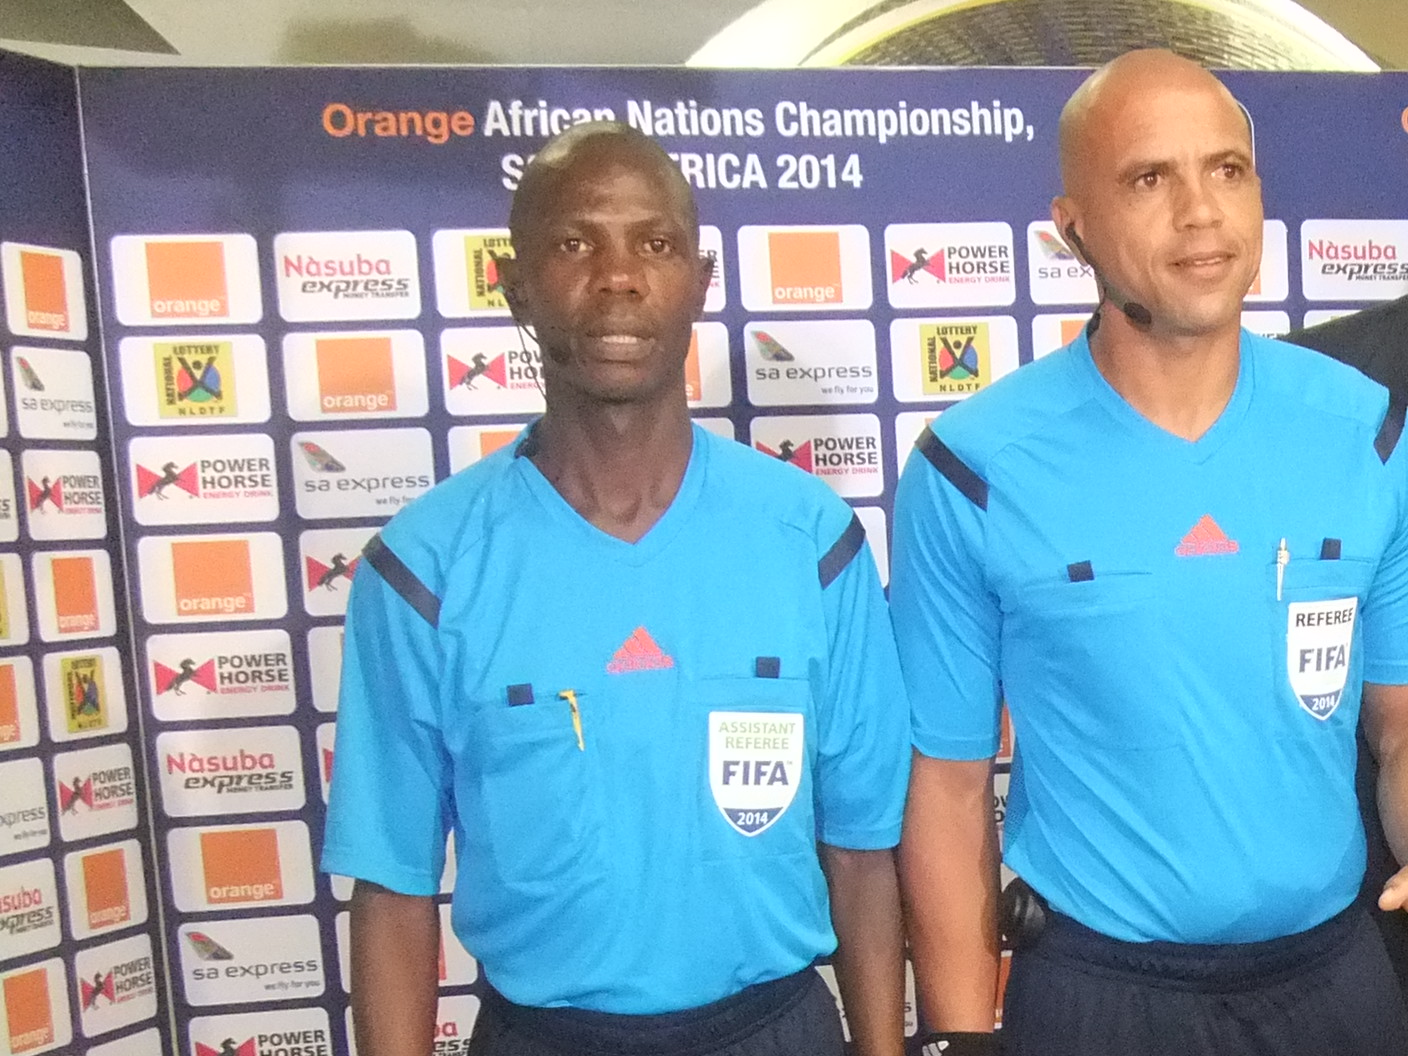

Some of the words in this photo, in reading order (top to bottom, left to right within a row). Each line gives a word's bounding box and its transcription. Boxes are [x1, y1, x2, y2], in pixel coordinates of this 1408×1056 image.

[323, 103, 475, 144] Orange
[627, 100, 764, 138] Nations
[775, 101, 1034, 143] Championship,
[776, 153, 863, 188] 2014
[947, 245, 1009, 260] POWER
[1308, 240, 1397, 260] Nàsuba
[284, 254, 391, 278] Nàsuba
[474, 249, 485, 297] NATIONAL
[949, 260, 1010, 274] HORSE
[1038, 266, 1061, 278] sa
[301, 278, 410, 299] express
[775, 284, 836, 302] orange
[154, 299, 221, 316] orange
[28, 309, 66, 328] orange
[936, 326, 977, 336] LOTTERY
[173, 345, 220, 356] LOTTERY
[929, 337, 938, 383] NATIONAL
[163, 356, 172, 405] NATIONAL
[755, 367, 780, 380] sa
[786, 364, 872, 381] express
[41, 398, 94, 417] express
[323, 393, 388, 410] orange
[814, 436, 877, 451] POWER
[201, 459, 270, 473] POWER
[815, 452, 878, 467] HORSE
[815, 467, 849, 476] ENERGY
[851, 467, 878, 475] DRINK
[62, 475, 100, 490] POWER
[202, 474, 272, 489] HORSE
[304, 478, 331, 493] sa
[337, 475, 430, 493] express
[64, 490, 102, 506] HORSE
[180, 594, 246, 612] orange
[59, 612, 96, 632] orange
[1296, 607, 1354, 628] REFEREE
[218, 653, 287, 669] POWER
[1299, 644, 1347, 673] FIFA
[220, 669, 289, 684] HORSE
[1311, 695, 1336, 711] 2014
[718, 721, 796, 735] ASSISTANT
[725, 736, 789, 750] REFEREE
[166, 750, 275, 775] Nàsuba
[92, 767, 131, 786] POWER
[722, 760, 789, 786] FIFA
[95, 782, 134, 801] HORSE
[184, 771, 293, 794] express
[737, 812, 769, 826] 2014
[210, 883, 275, 900] orange
[89, 903, 128, 926] orange
[113, 956, 151, 980] POWER
[192, 966, 219, 981] sa
[225, 959, 318, 980] express
[115, 971, 153, 994] HORSE
[258, 1030, 325, 1046] POWER
